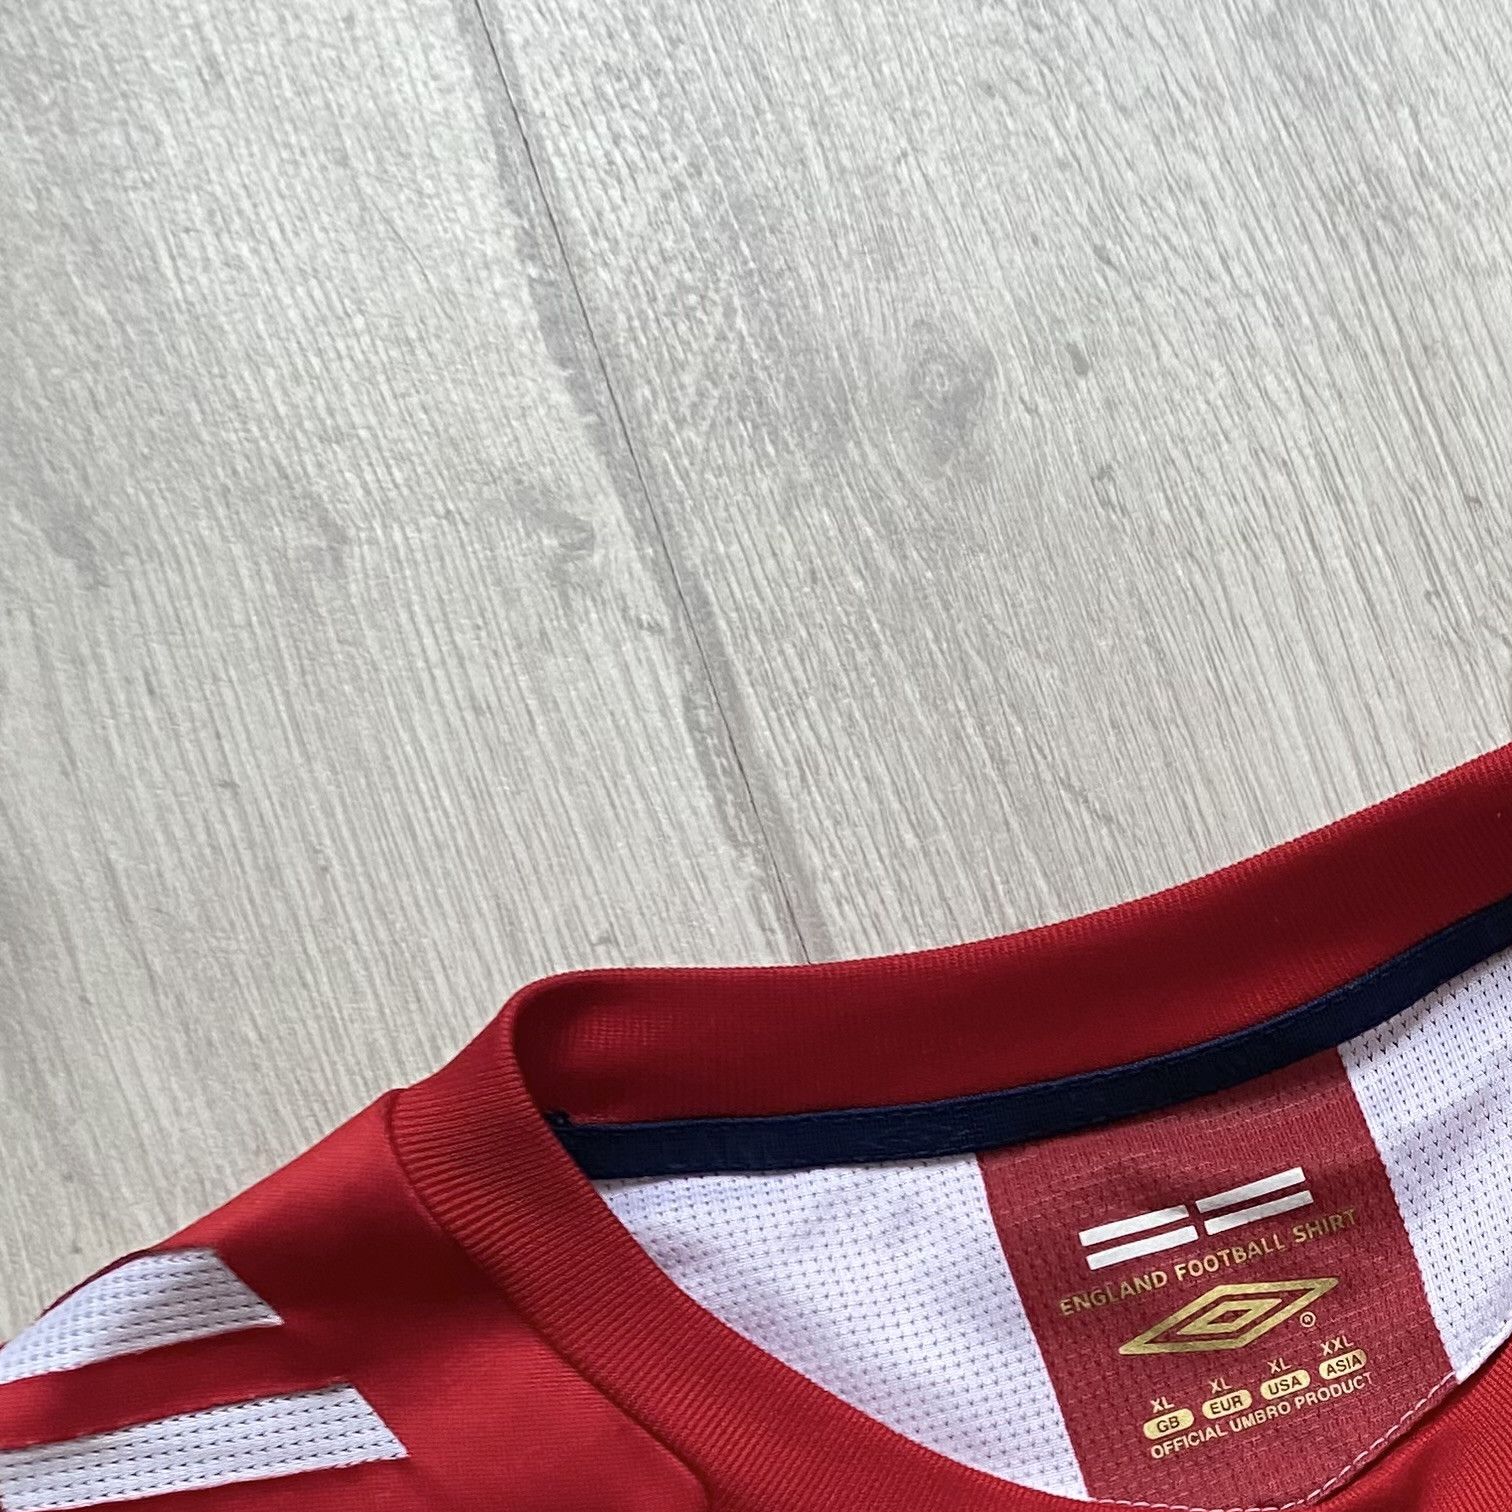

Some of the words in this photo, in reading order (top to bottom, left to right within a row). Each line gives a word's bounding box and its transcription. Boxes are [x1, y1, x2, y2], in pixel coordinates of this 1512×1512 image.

[1059, 1270, 1168, 1316] ENGLAND
[1174, 1234, 1286, 1281] FOOTBALL
[1292, 1208, 1356, 1243] SHIRT
[1150, 1396, 1175, 1414] XL
[1208, 1376, 1232, 1394] XL
[1267, 1357, 1292, 1374] XL
[1320, 1335, 1354, 1357] XXL
[1150, 1424, 1228, 1459] OFFICIAL
[1229, 1401, 1291, 1432] UMBRO
[1295, 1371, 1373, 1410] PRODUCT
[1156, 1415, 1180, 1433] GB
[1209, 1395, 1243, 1415] EUR
[1267, 1375, 1302, 1395] USA
[1326, 1355, 1362, 1376] ASIA
